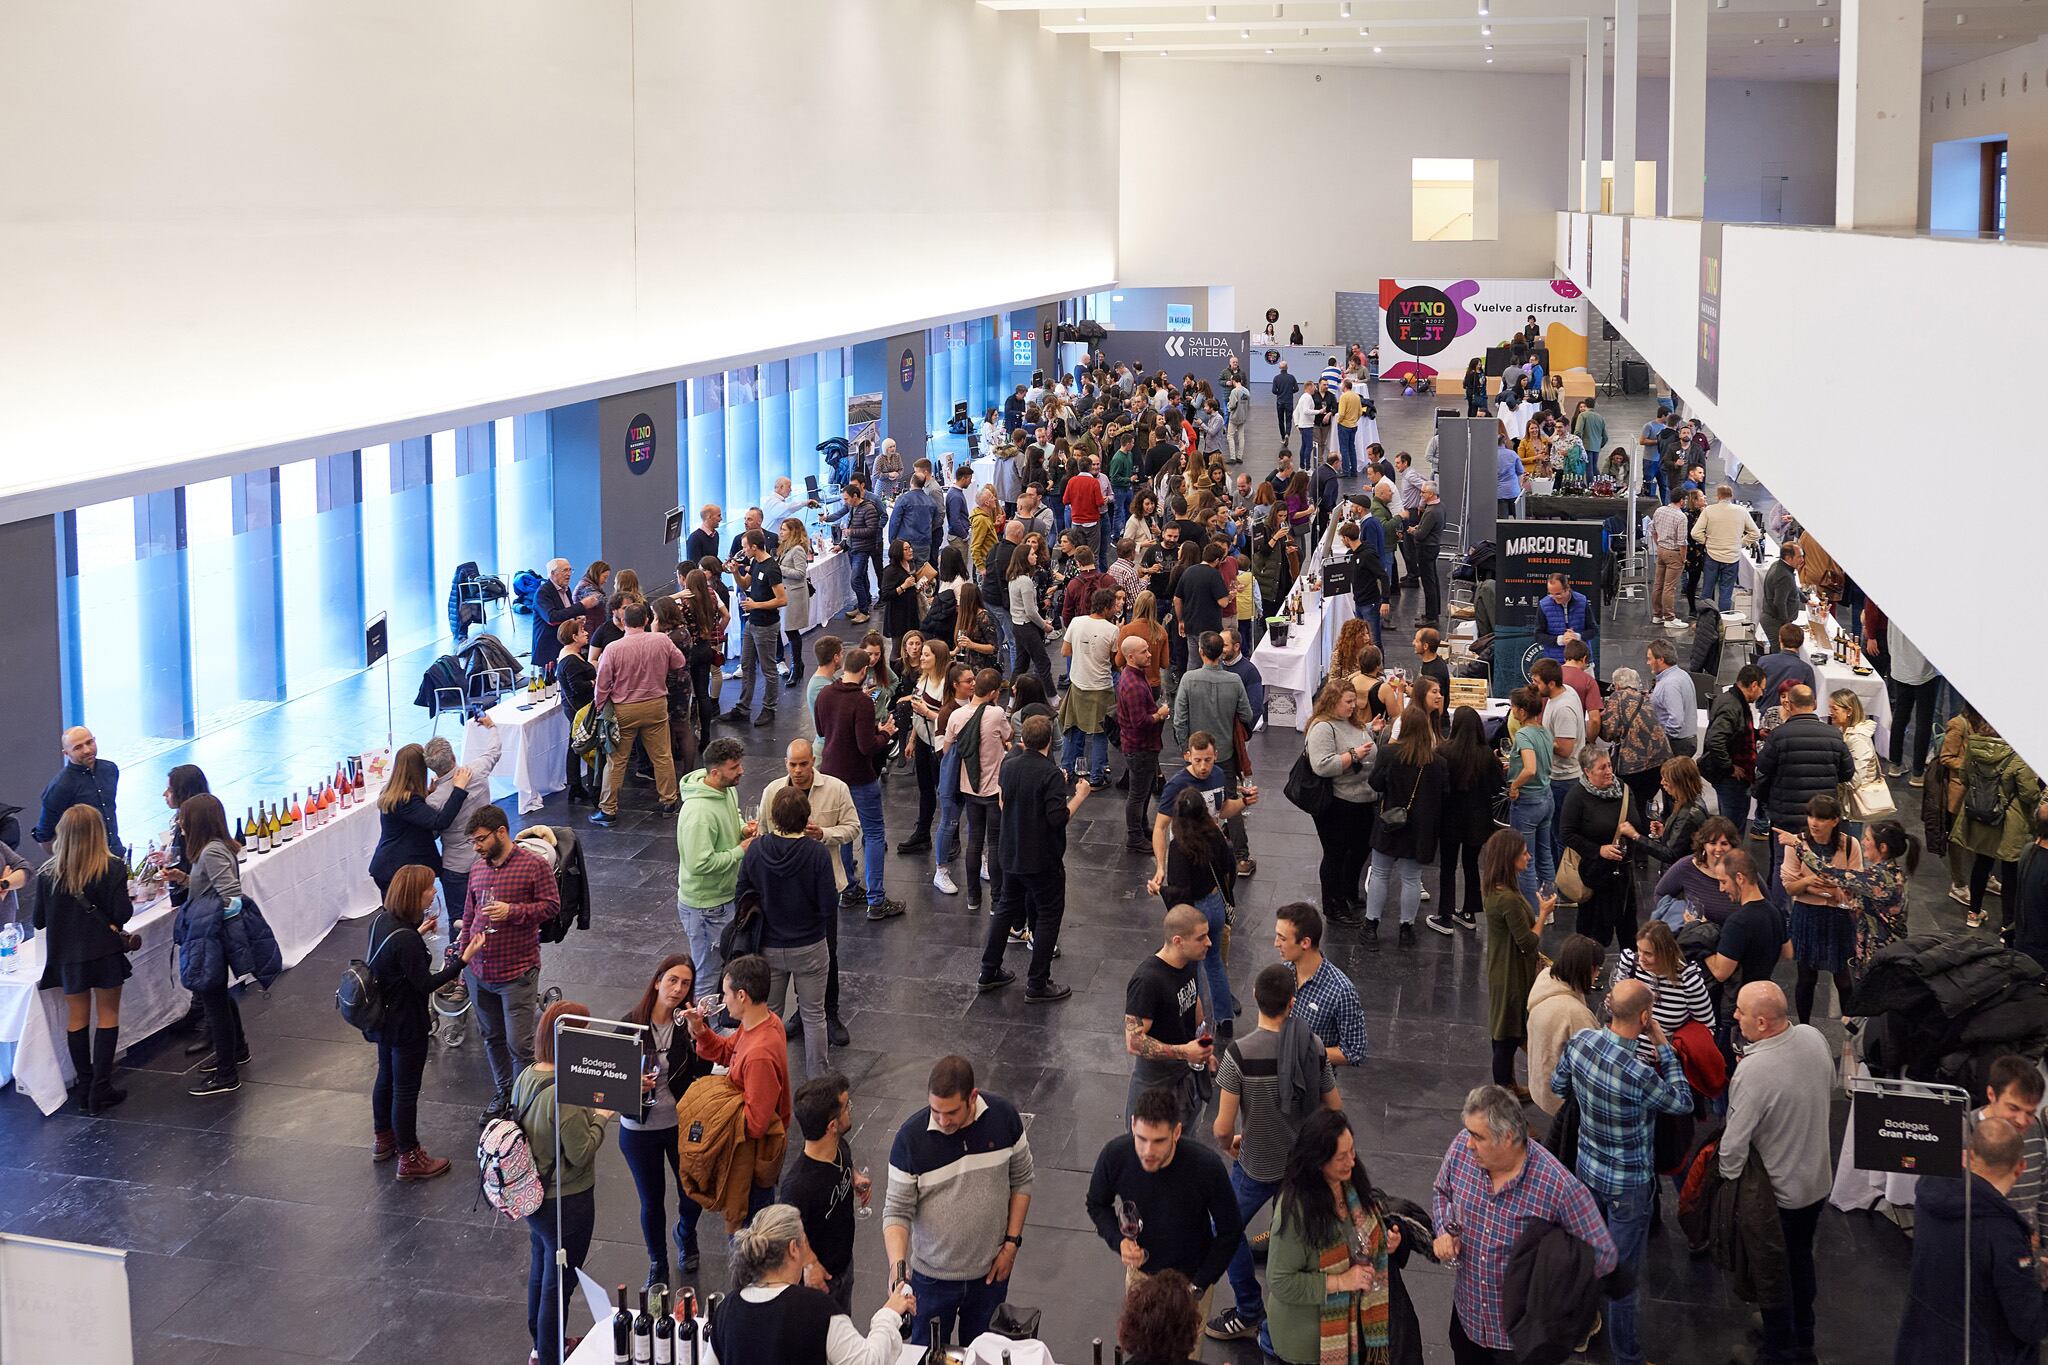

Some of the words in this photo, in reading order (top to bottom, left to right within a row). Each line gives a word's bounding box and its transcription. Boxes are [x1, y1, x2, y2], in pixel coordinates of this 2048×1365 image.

[1399, 301, 1445, 316] VINO
[1473, 303, 1512, 312] Vuelve
[1525, 303, 1578, 313] disfrutar.
[1400, 326, 1444, 340] FST
[1188, 337, 1229, 347] SALIDA
[1188, 347, 1234, 357] IRTEERA
[630, 426, 651, 441] VINO
[631, 447, 650, 463] FEST
[1506, 536, 1555, 557] MARCO
[1556, 537, 1593, 559] REAL
[582, 1057, 617, 1069] Bodegas
[570, 1064, 602, 1076] Máximo
[602, 1069, 628, 1080] Abete
[1884, 1119, 1930, 1132] Bodegas
[1878, 1128, 1904, 1139] Gran
[1905, 1131, 1939, 1142] Feudo
